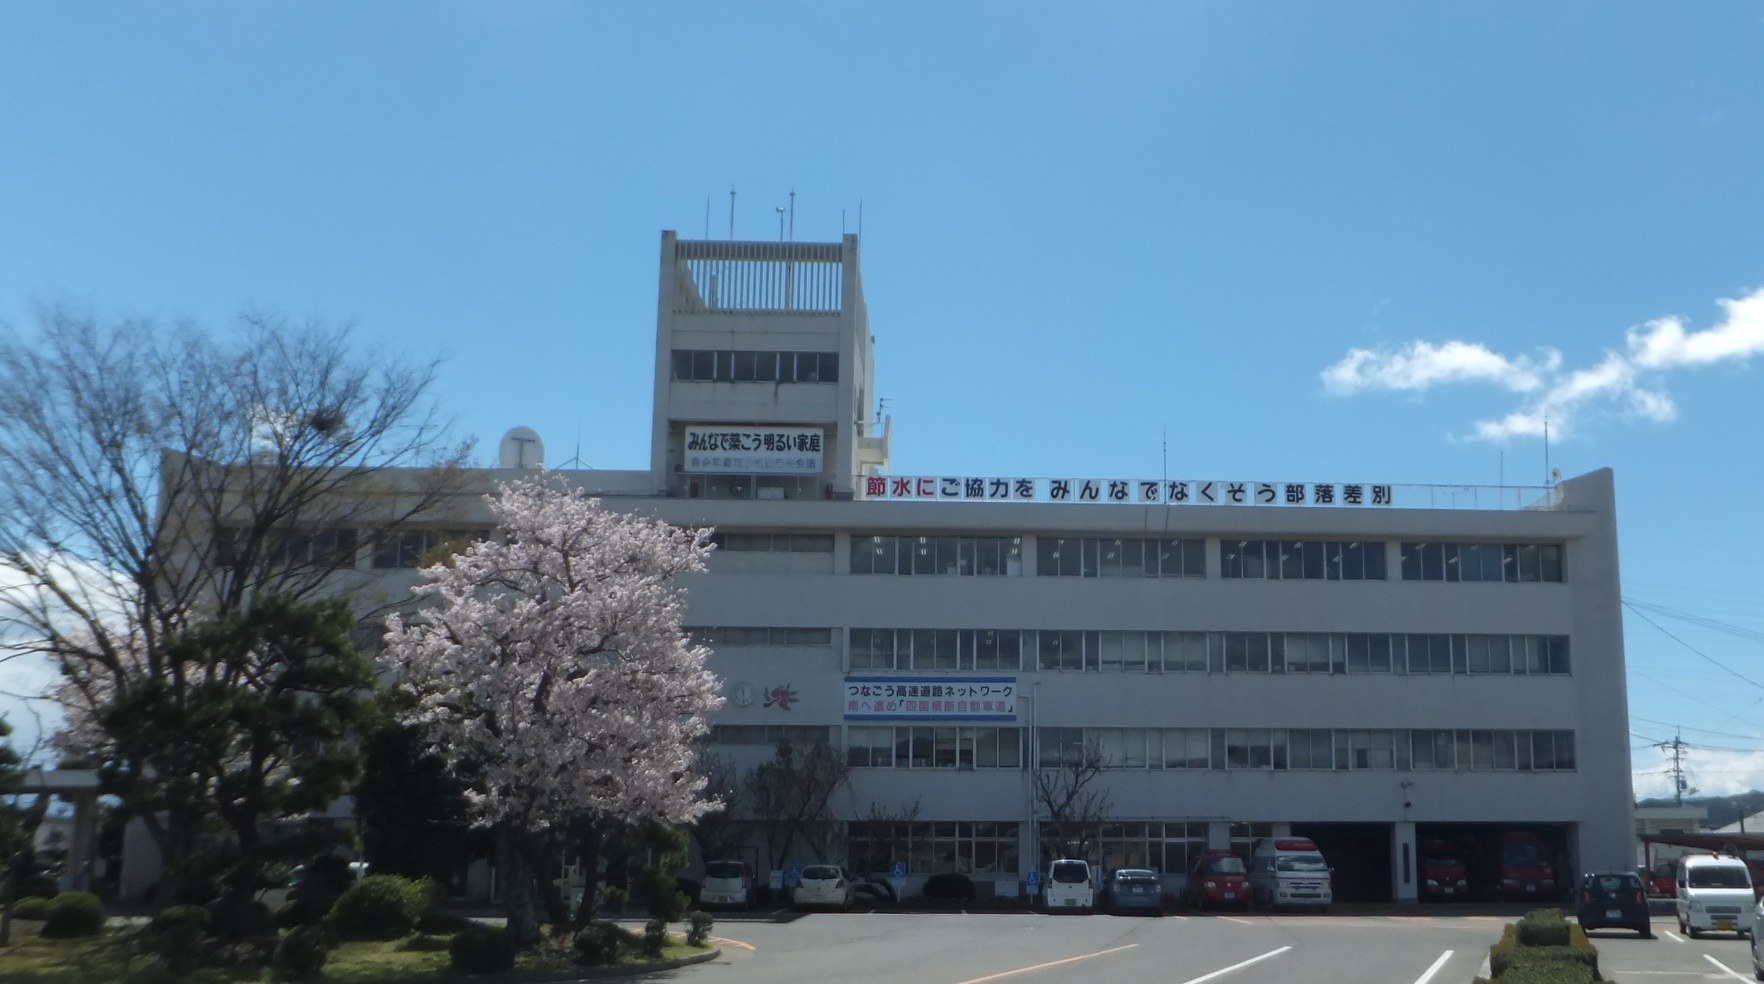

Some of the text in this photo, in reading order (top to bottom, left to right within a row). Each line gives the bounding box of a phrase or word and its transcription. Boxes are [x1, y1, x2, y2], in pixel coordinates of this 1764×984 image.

[866, 477, 1392, 504] 節水にご協力を みんなでなくそう部落差別
[848, 685, 1013, 698] つなごう高速道路ネットワーク
